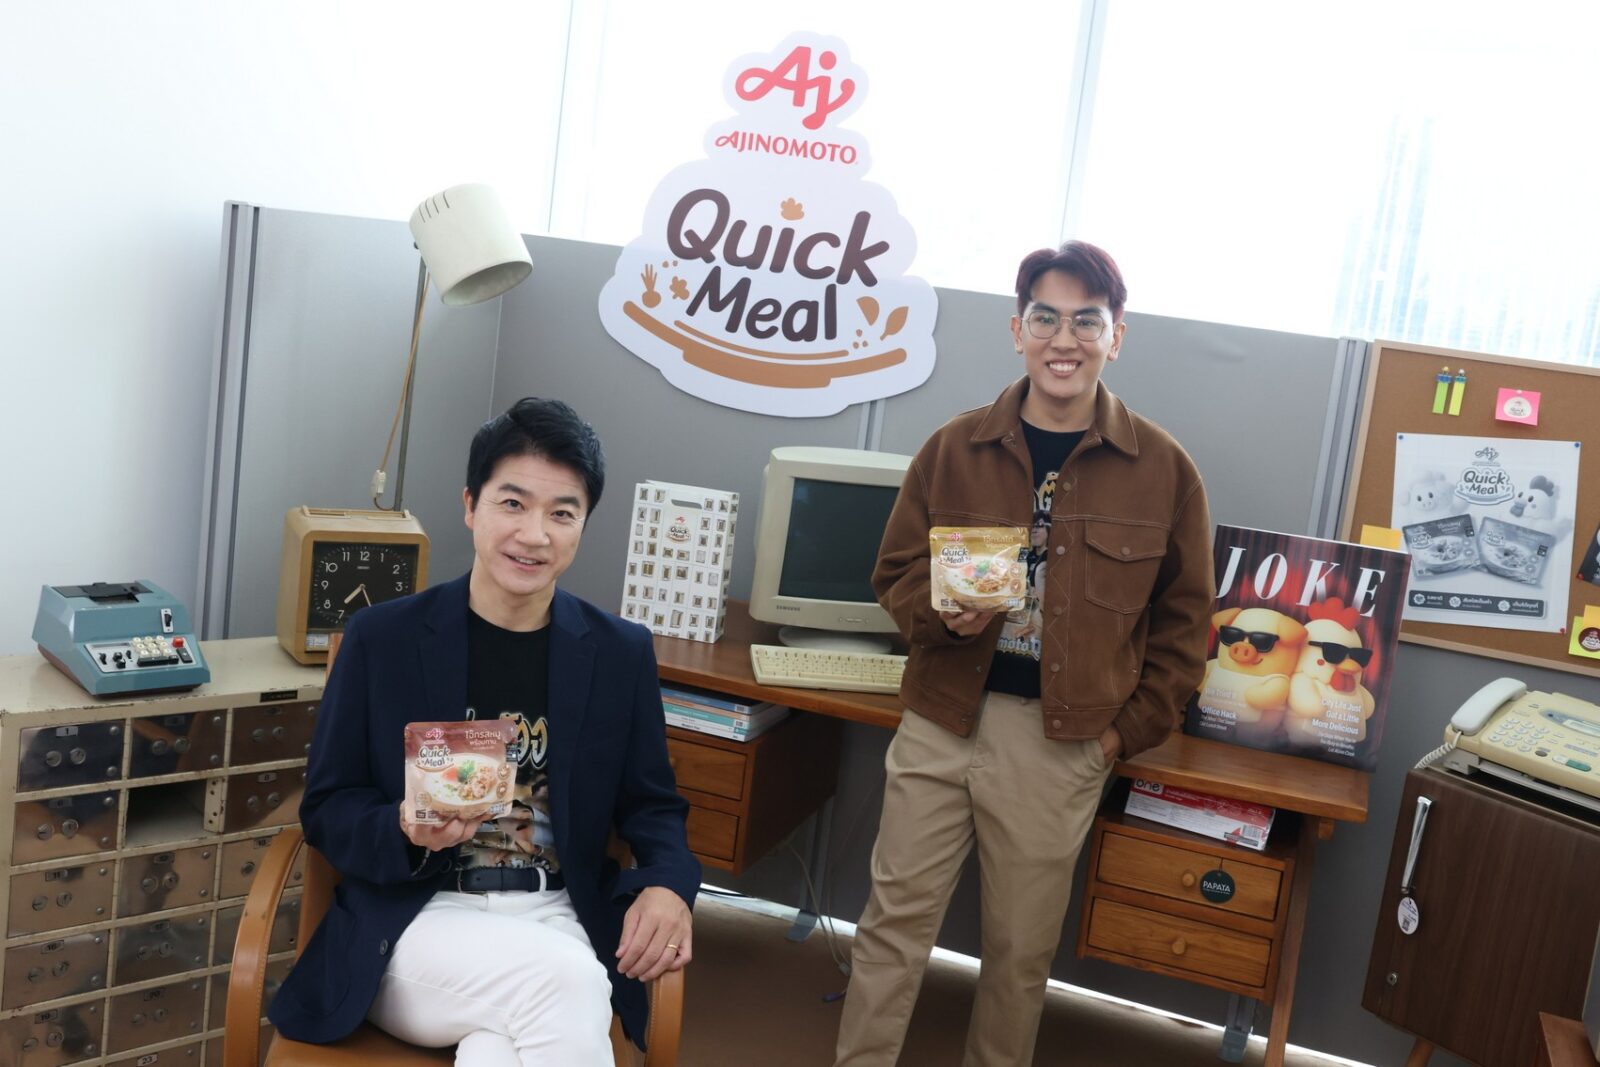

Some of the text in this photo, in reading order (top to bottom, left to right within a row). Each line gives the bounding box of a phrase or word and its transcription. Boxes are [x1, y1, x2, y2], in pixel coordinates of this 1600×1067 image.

[714, 130, 857, 165] AJINOMOTO
[666, 188, 890, 287] Quick
[686, 265, 837, 342] Meal
[1463, 470, 1506, 485] Quick
[1469, 483, 1498, 495] Meal
[342, 551, 350, 561] 11
[360, 551, 370, 561] 12
[380, 552, 384, 562] 1
[941, 547, 968, 557] Quick
[325, 562, 338, 573] 10
[392, 564, 400, 574] 2
[321, 580, 329, 589] 9
[395, 582, 403, 592] 3
[1216, 546, 1386, 618] JOKE
[323, 599, 331, 609] 8
[338, 610, 345, 619] 7
[1312, 718, 1359, 735] More Delicious
[420, 746, 449, 758] Quick
[424, 757, 446, 767] Meal
[1203, 880, 1231, 893] PAPAYA
[142, 1055, 153, 1065] 23
